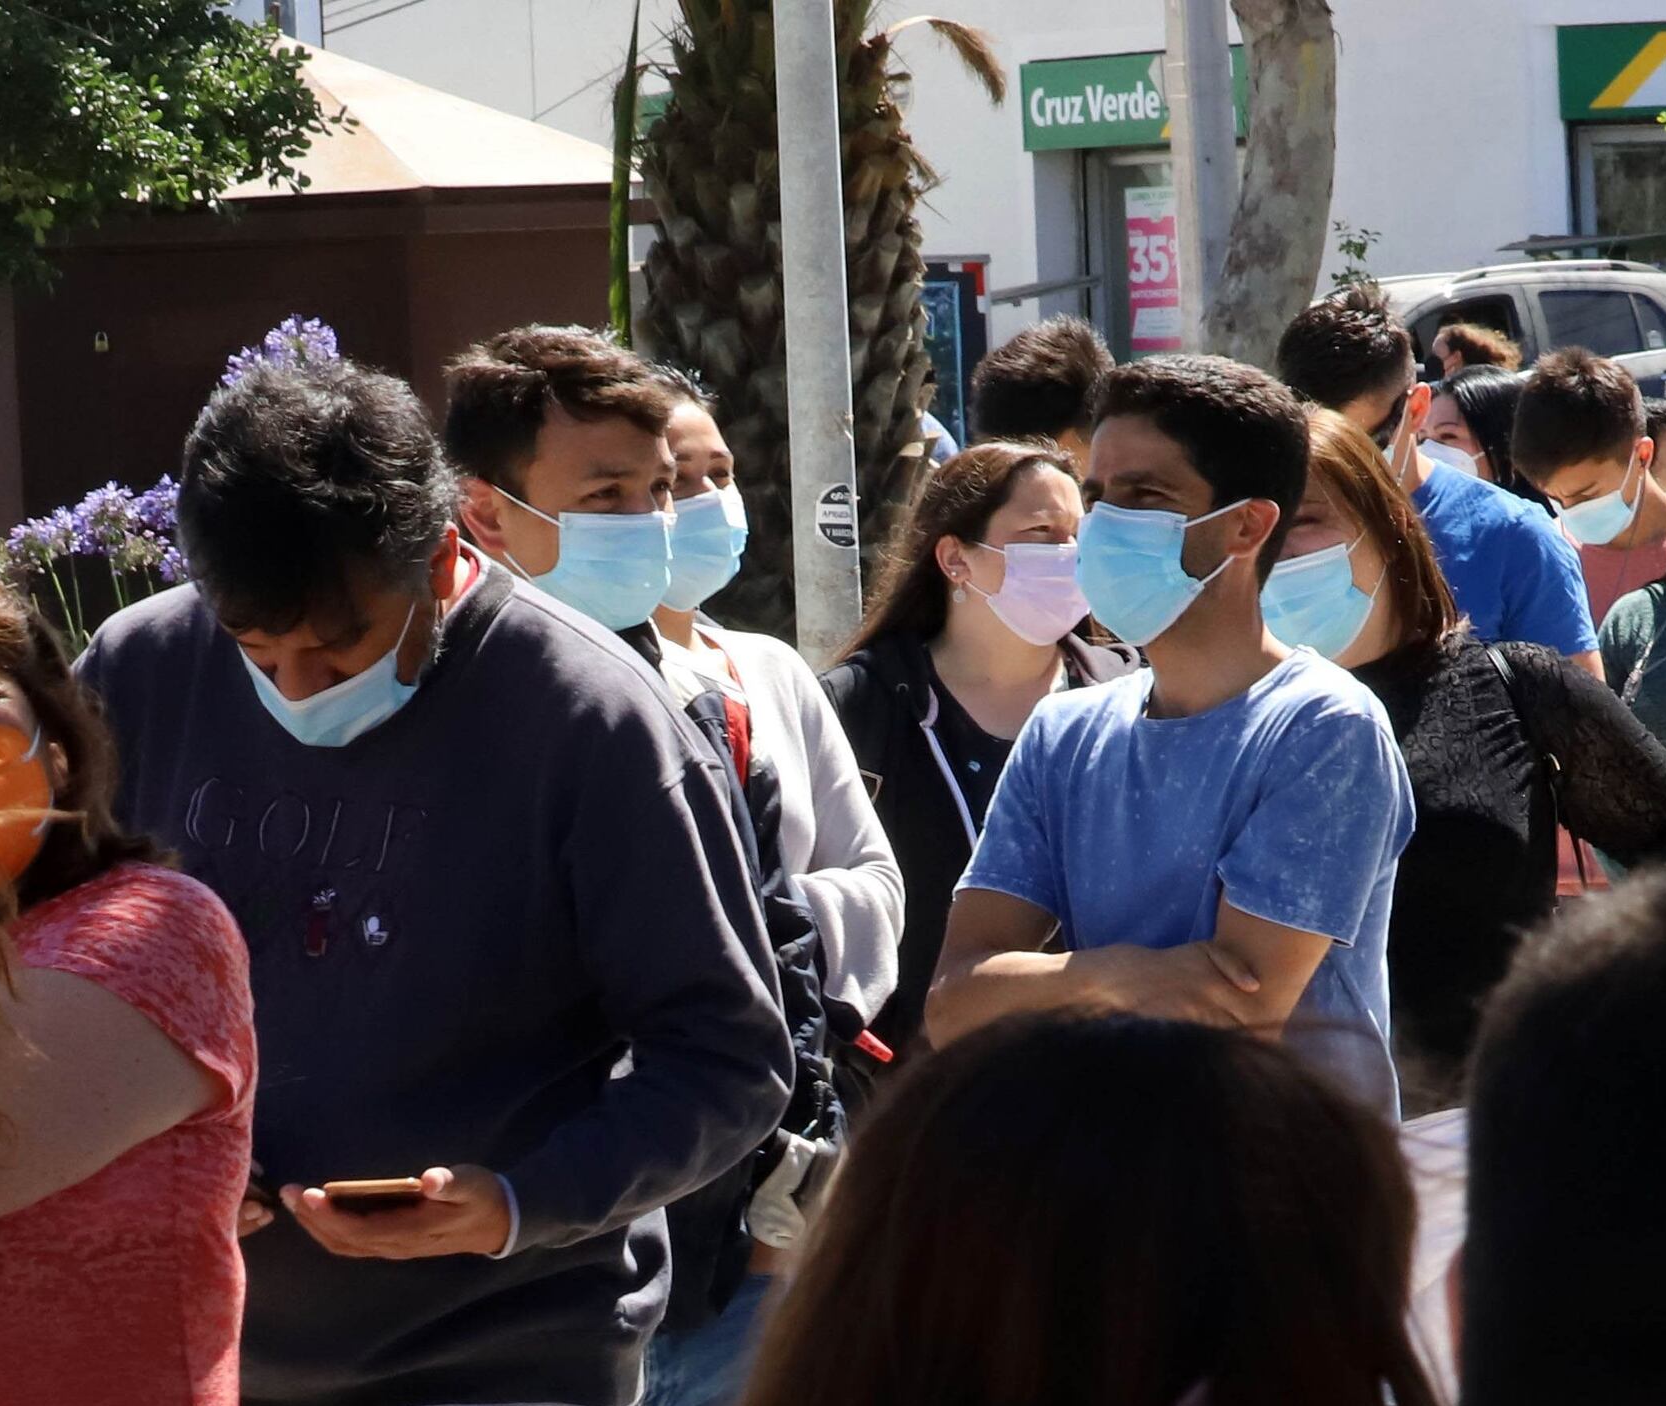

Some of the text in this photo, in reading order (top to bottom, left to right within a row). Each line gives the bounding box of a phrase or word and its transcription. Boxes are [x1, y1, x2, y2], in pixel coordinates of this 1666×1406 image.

[1030, 80, 1162, 127] Cruz Verde
[185, 777, 430, 872] GOLF
